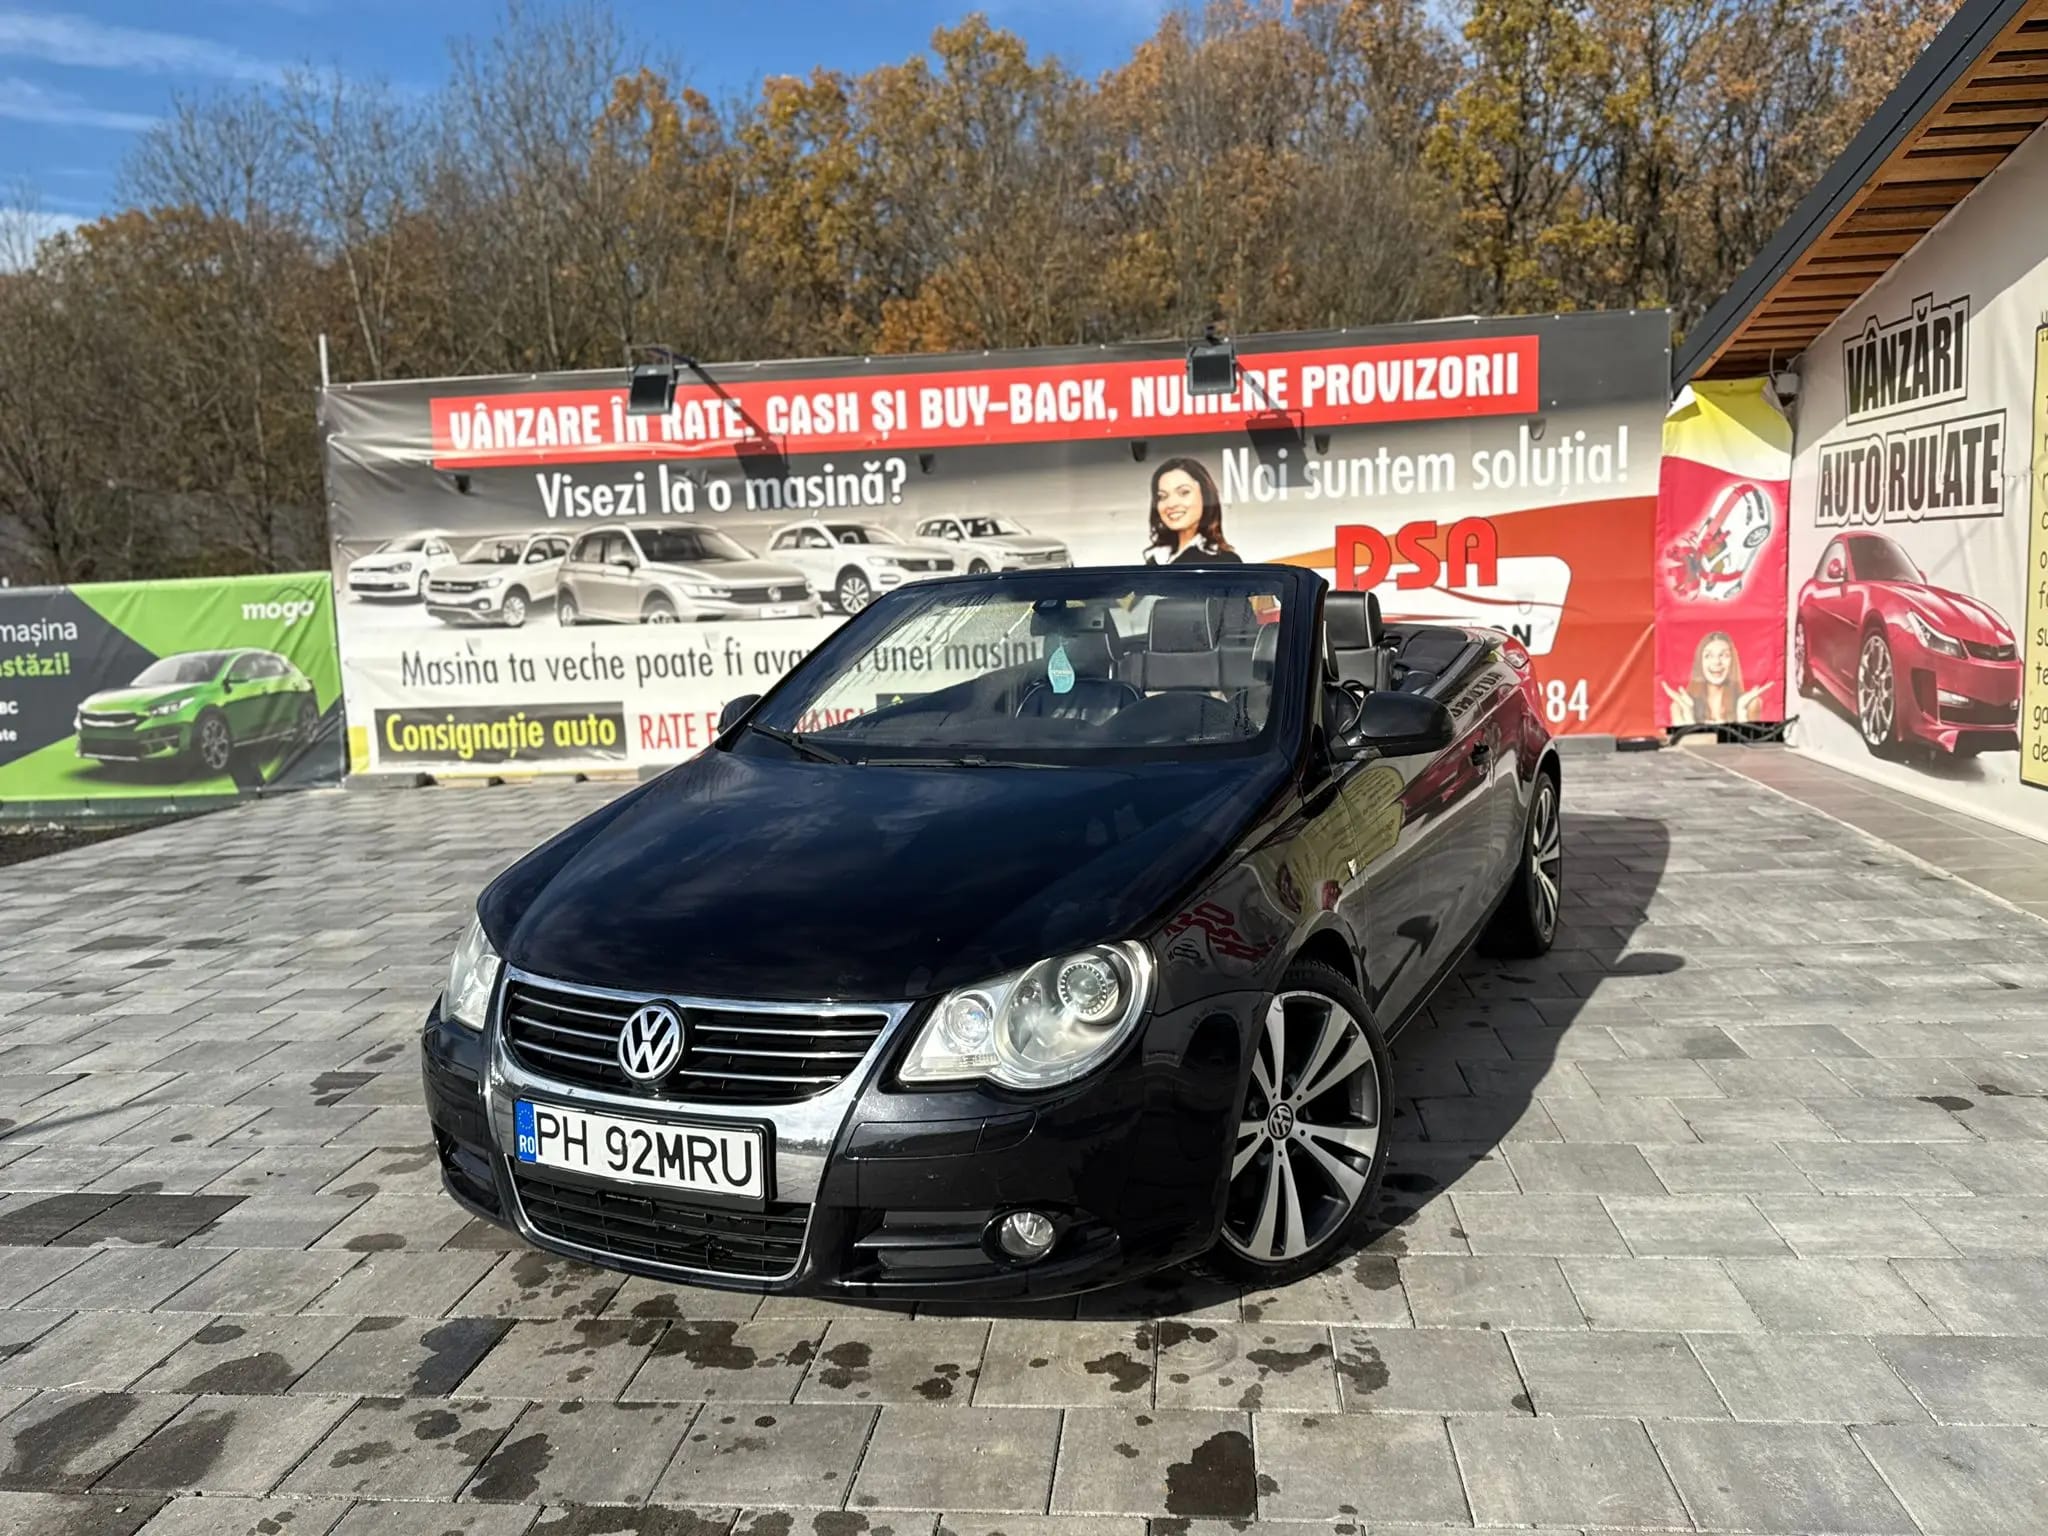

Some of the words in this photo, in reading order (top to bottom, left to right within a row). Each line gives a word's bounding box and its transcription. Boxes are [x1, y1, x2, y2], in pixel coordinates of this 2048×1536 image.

[1847, 306, 1964, 415] VÂNZĂRI
[450, 402, 602, 450] VÂNZARE
[766, 393, 860, 436] CASH
[920, 378, 1118, 430] BUY-BACK,
[1301, 352, 1518, 408] PROVIZORII
[536, 471, 647, 519] Visezi
[658, 463, 695, 514] la
[708, 479, 732, 512] o
[1221, 448, 1288, 504] Noi
[1303, 447, 1456, 500] suntem
[1335, 516, 1498, 592] DSA
[241, 600, 315, 626] mogo
[0, 651, 71, 677] stăzi!
[508, 653, 535, 683] ta
[545, 640, 625, 682] veche
[636, 646, 713, 689] poate
[724, 635, 743, 676] fi
[873, 635, 934, 672] unei
[1537, 678, 1589, 724] 84
[385, 712, 545, 760] Consignație
[553, 712, 617, 748] auto
[639, 711, 698, 750] RATE
[519, 1134, 536, 1154] RO
[536, 1111, 589, 1165] PH
